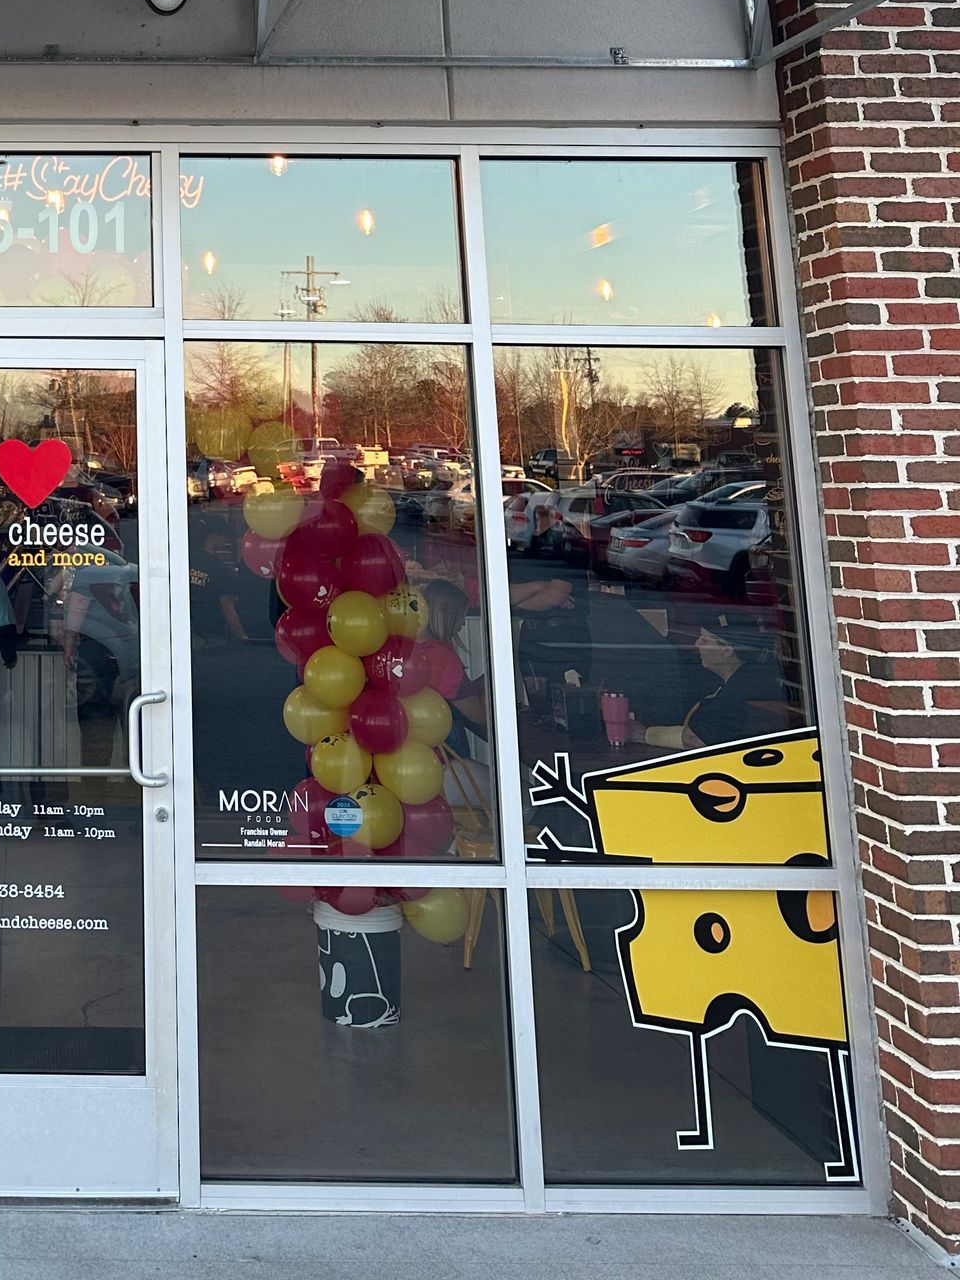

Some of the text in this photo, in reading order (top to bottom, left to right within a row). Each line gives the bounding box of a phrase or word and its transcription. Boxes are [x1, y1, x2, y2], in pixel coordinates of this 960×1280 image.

[8, 516, 105, 546] cheese
[8, 550, 106, 567] and more
[219, 789, 309, 813] MORAN
[33, 805, 64, 816] 11am
[74, 806, 105, 816] 10pm
[246, 815, 282, 823] FOOD
[44, 827, 75, 838] 11am
[85, 828, 116, 839] 10pm
[240, 826, 289, 836] Franchise Owner
[243, 838, 286, 848] Randall Moran
